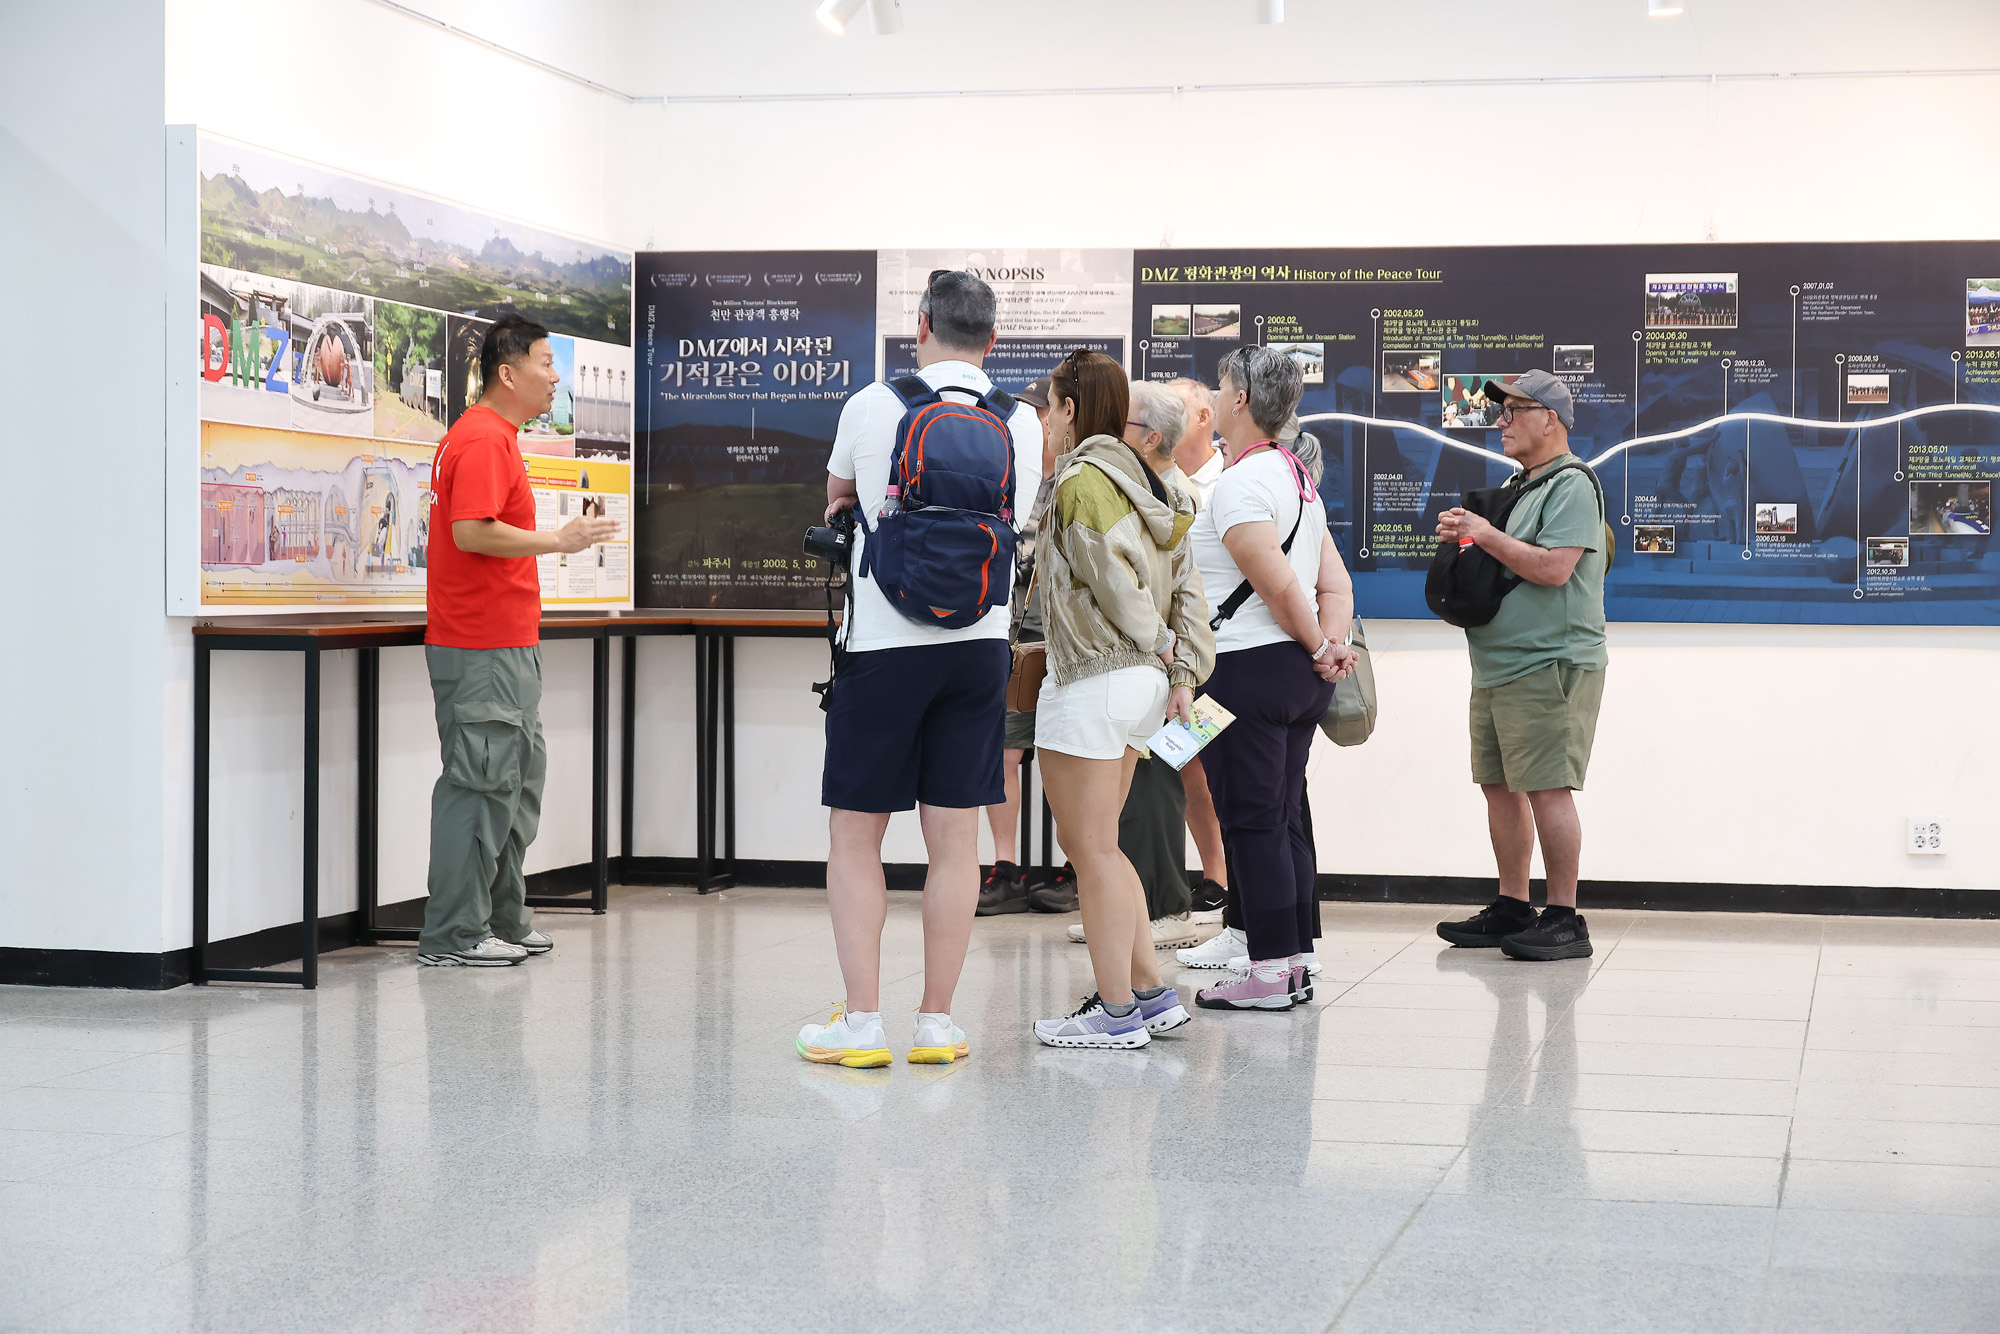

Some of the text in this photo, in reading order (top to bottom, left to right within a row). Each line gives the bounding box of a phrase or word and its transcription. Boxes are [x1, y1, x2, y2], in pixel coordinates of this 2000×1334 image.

[1141, 265, 1442, 281] DMZ 평화관광의 역사 History of the Peace Tour
[710, 309, 800, 321] 천만 관광객 흥행작
[1384, 310, 1424, 318] 2002.05.20
[1267, 316, 1298, 325] 2002.02.
[1646, 332, 1687, 340] 2004.06.30
[678, 336, 832, 357] DMZ에서 시작된
[660, 359, 850, 387] 기적같은 이야기
[681, 391, 726, 400] Miraculous
[728, 392, 750, 402] Story
[752, 391, 768, 400] that
[770, 392, 796, 402] Began
[799, 391, 806, 400] in
[808, 391, 822, 400] the
[1909, 445, 1948, 454] 2013.05.01
[1373, 524, 1412, 532] 2002.05.16
[702, 557, 731, 568] 파주시
[762, 559, 788, 569] 2002.
[792, 560, 800, 569] 5.
[804, 560, 817, 568] 30
